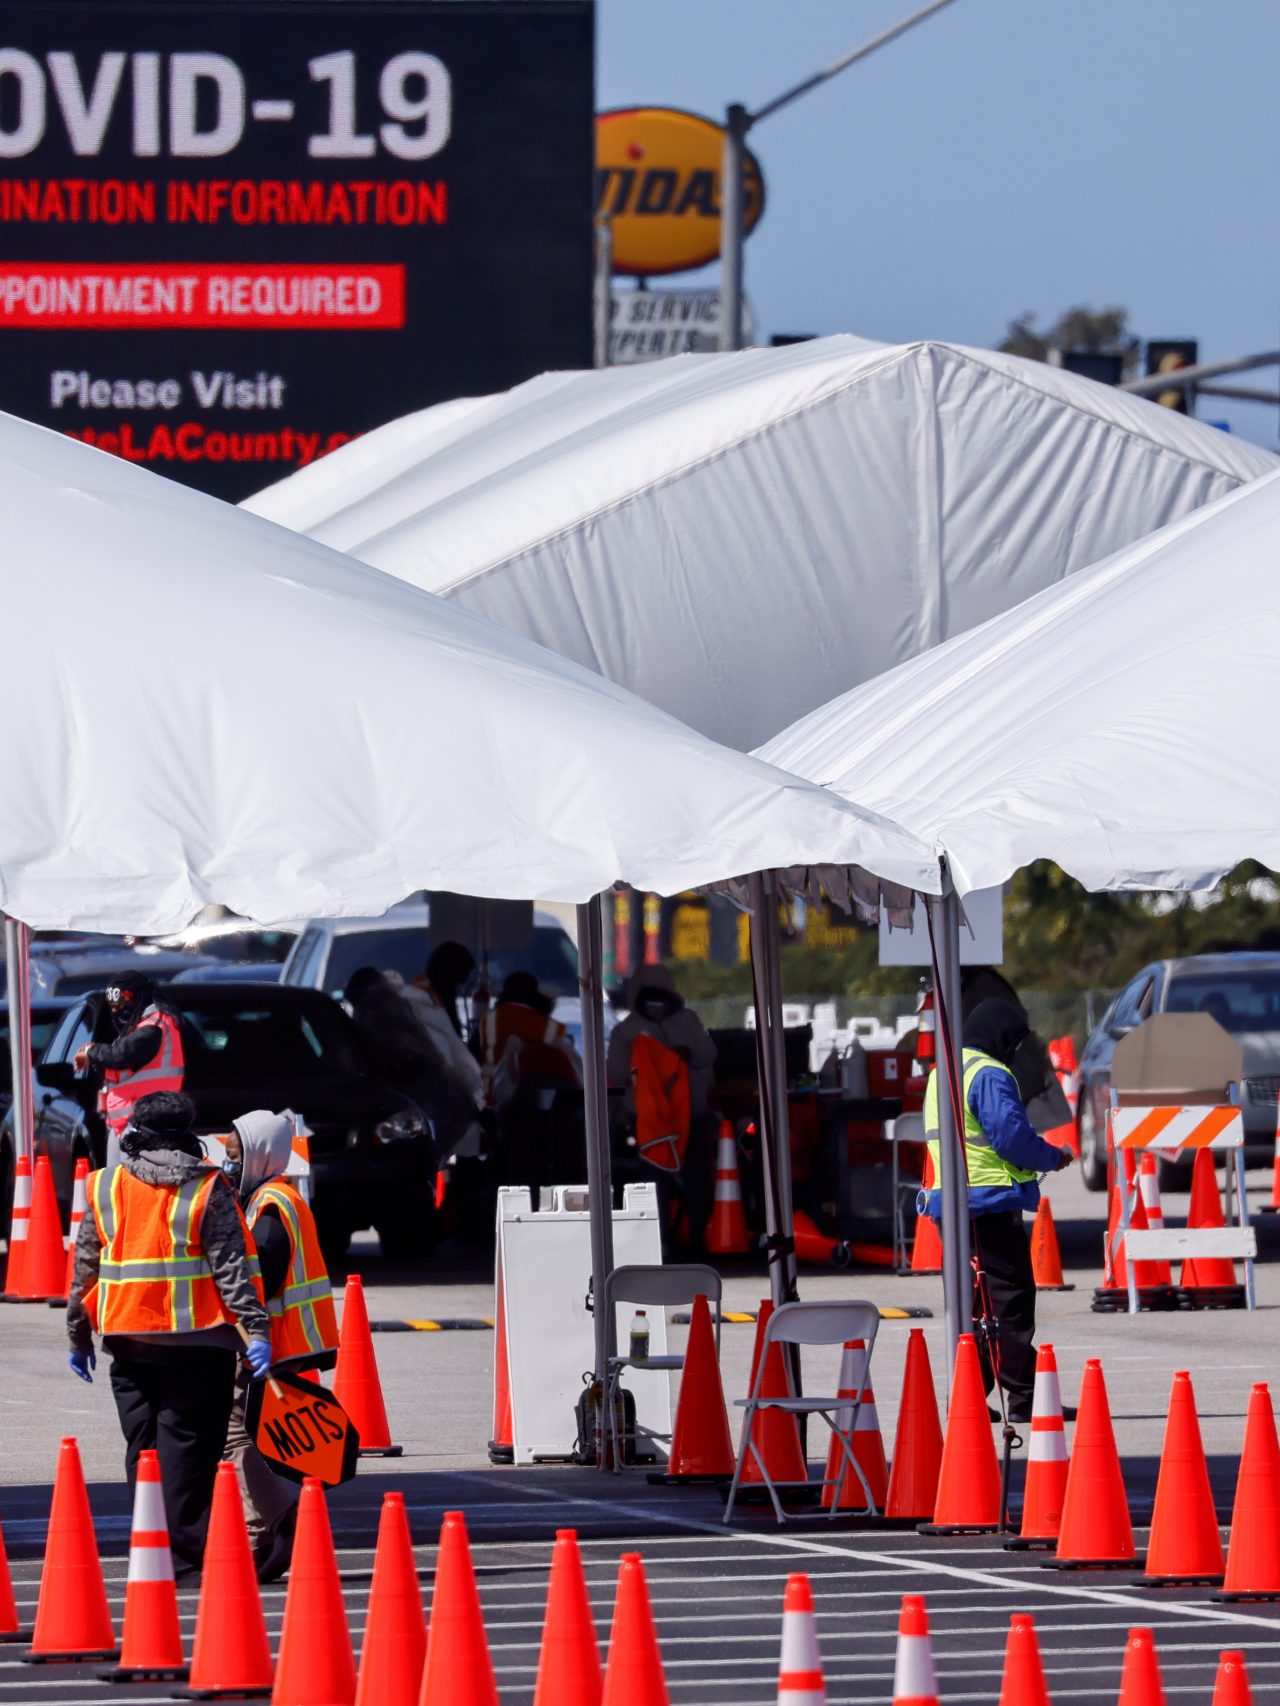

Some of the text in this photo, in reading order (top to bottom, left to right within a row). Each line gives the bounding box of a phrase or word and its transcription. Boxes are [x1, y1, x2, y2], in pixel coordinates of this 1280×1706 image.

[167, 179, 447, 225] INFORMATION
[208, 277, 381, 315] REQUIRED
[50, 370, 286, 408] Please Visit
